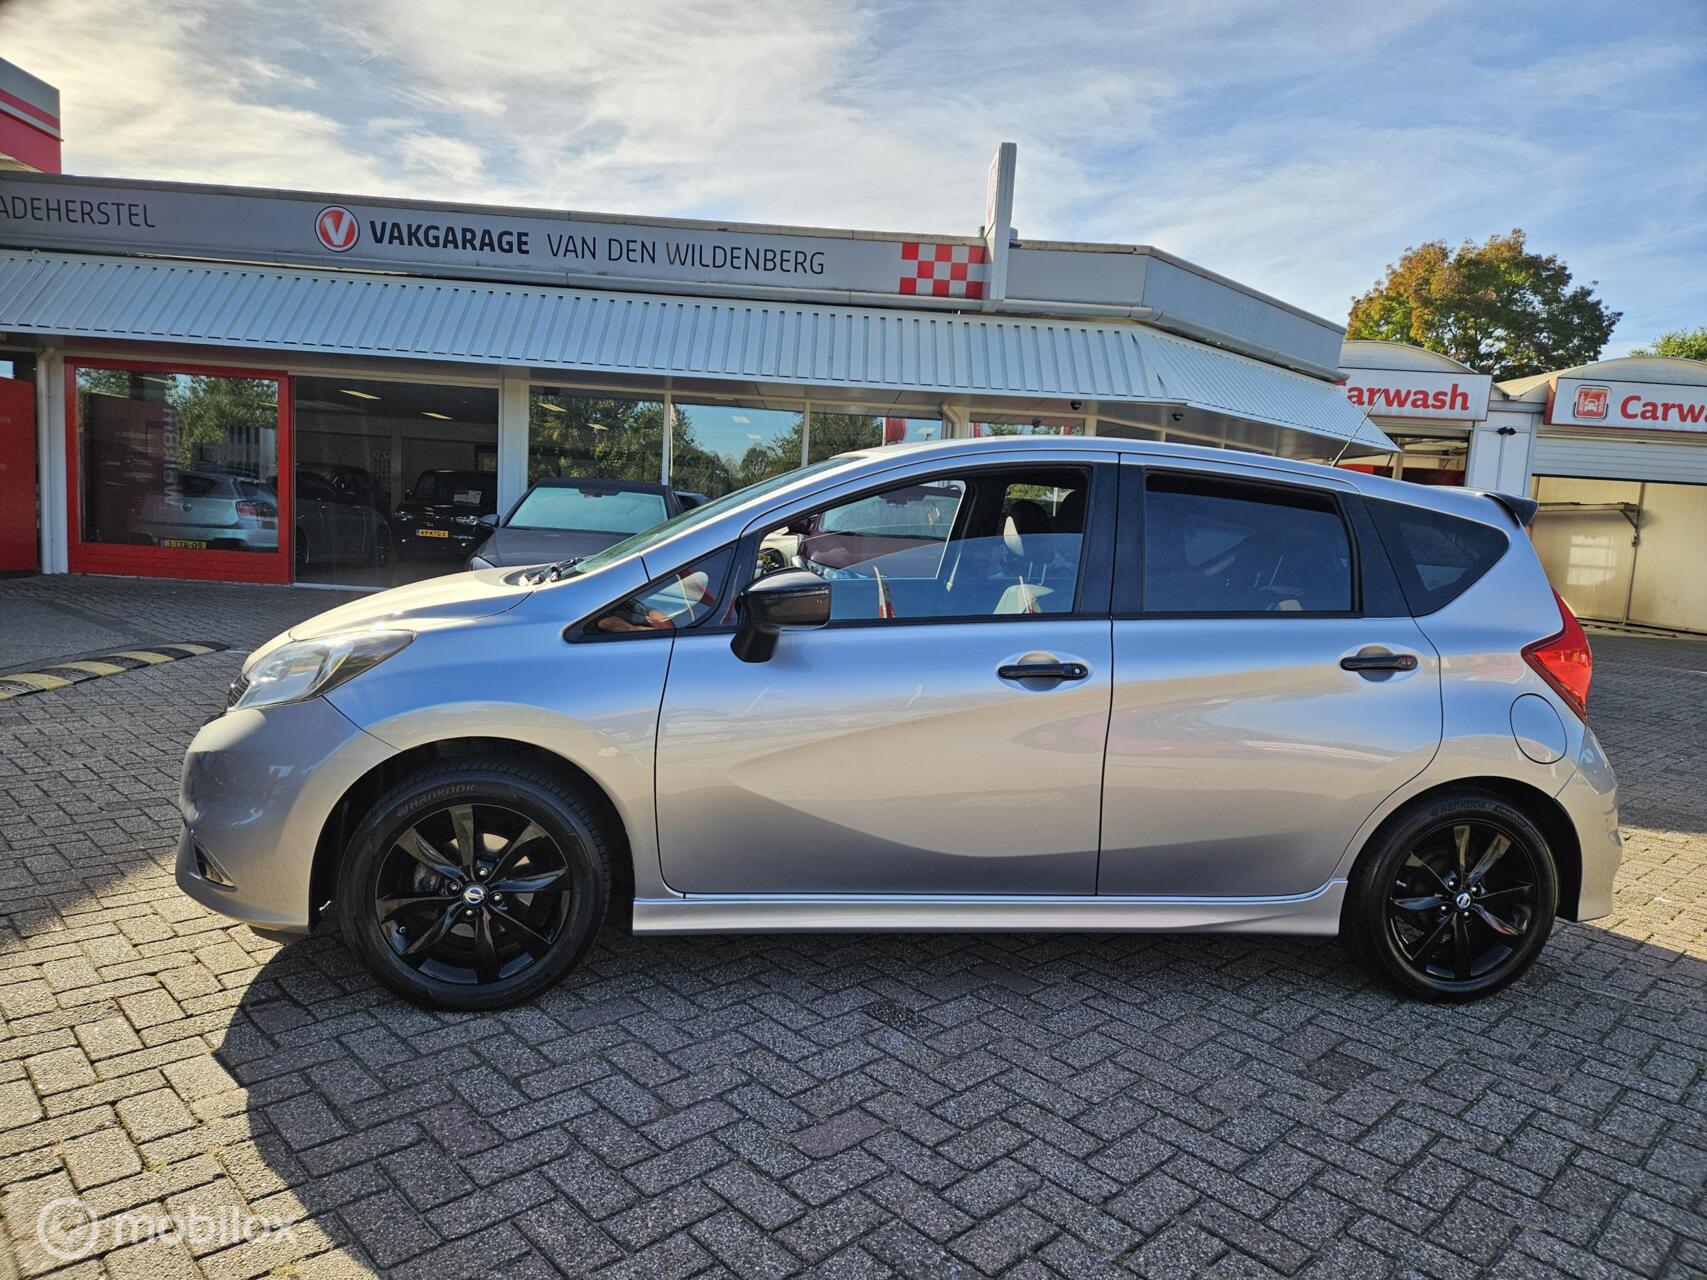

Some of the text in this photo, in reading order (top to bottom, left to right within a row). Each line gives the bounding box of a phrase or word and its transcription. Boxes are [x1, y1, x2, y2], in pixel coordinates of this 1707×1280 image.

[369, 220, 825, 275] VAKGARAGE VAN DEN WILDENBERG
[1336, 380, 1469, 411] arwash
[1620, 394, 1707, 423] Carw
